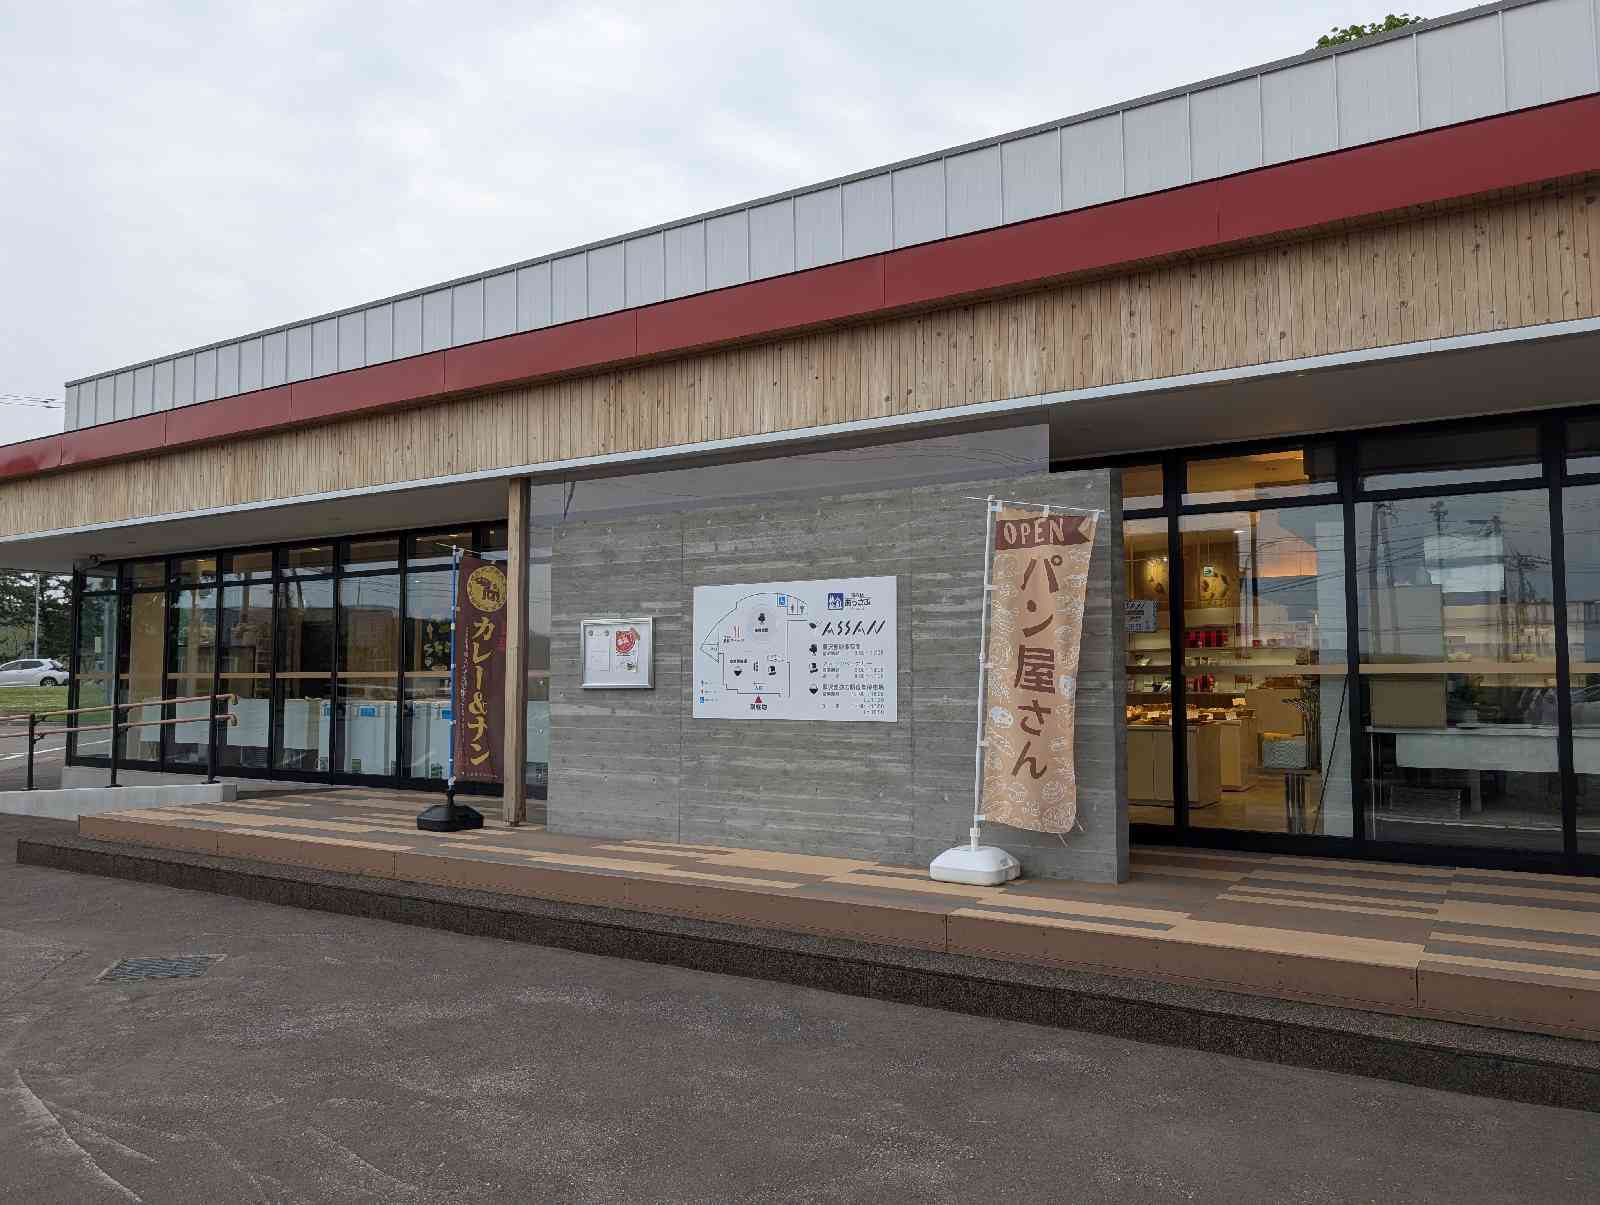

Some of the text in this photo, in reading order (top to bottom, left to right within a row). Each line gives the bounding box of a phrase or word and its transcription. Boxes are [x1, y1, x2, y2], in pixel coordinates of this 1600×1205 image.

[1003, 516, 1065, 546] OPEN
[821, 619, 886, 636] ASSAN
[1012, 554, 1063, 781] パン屋さん
